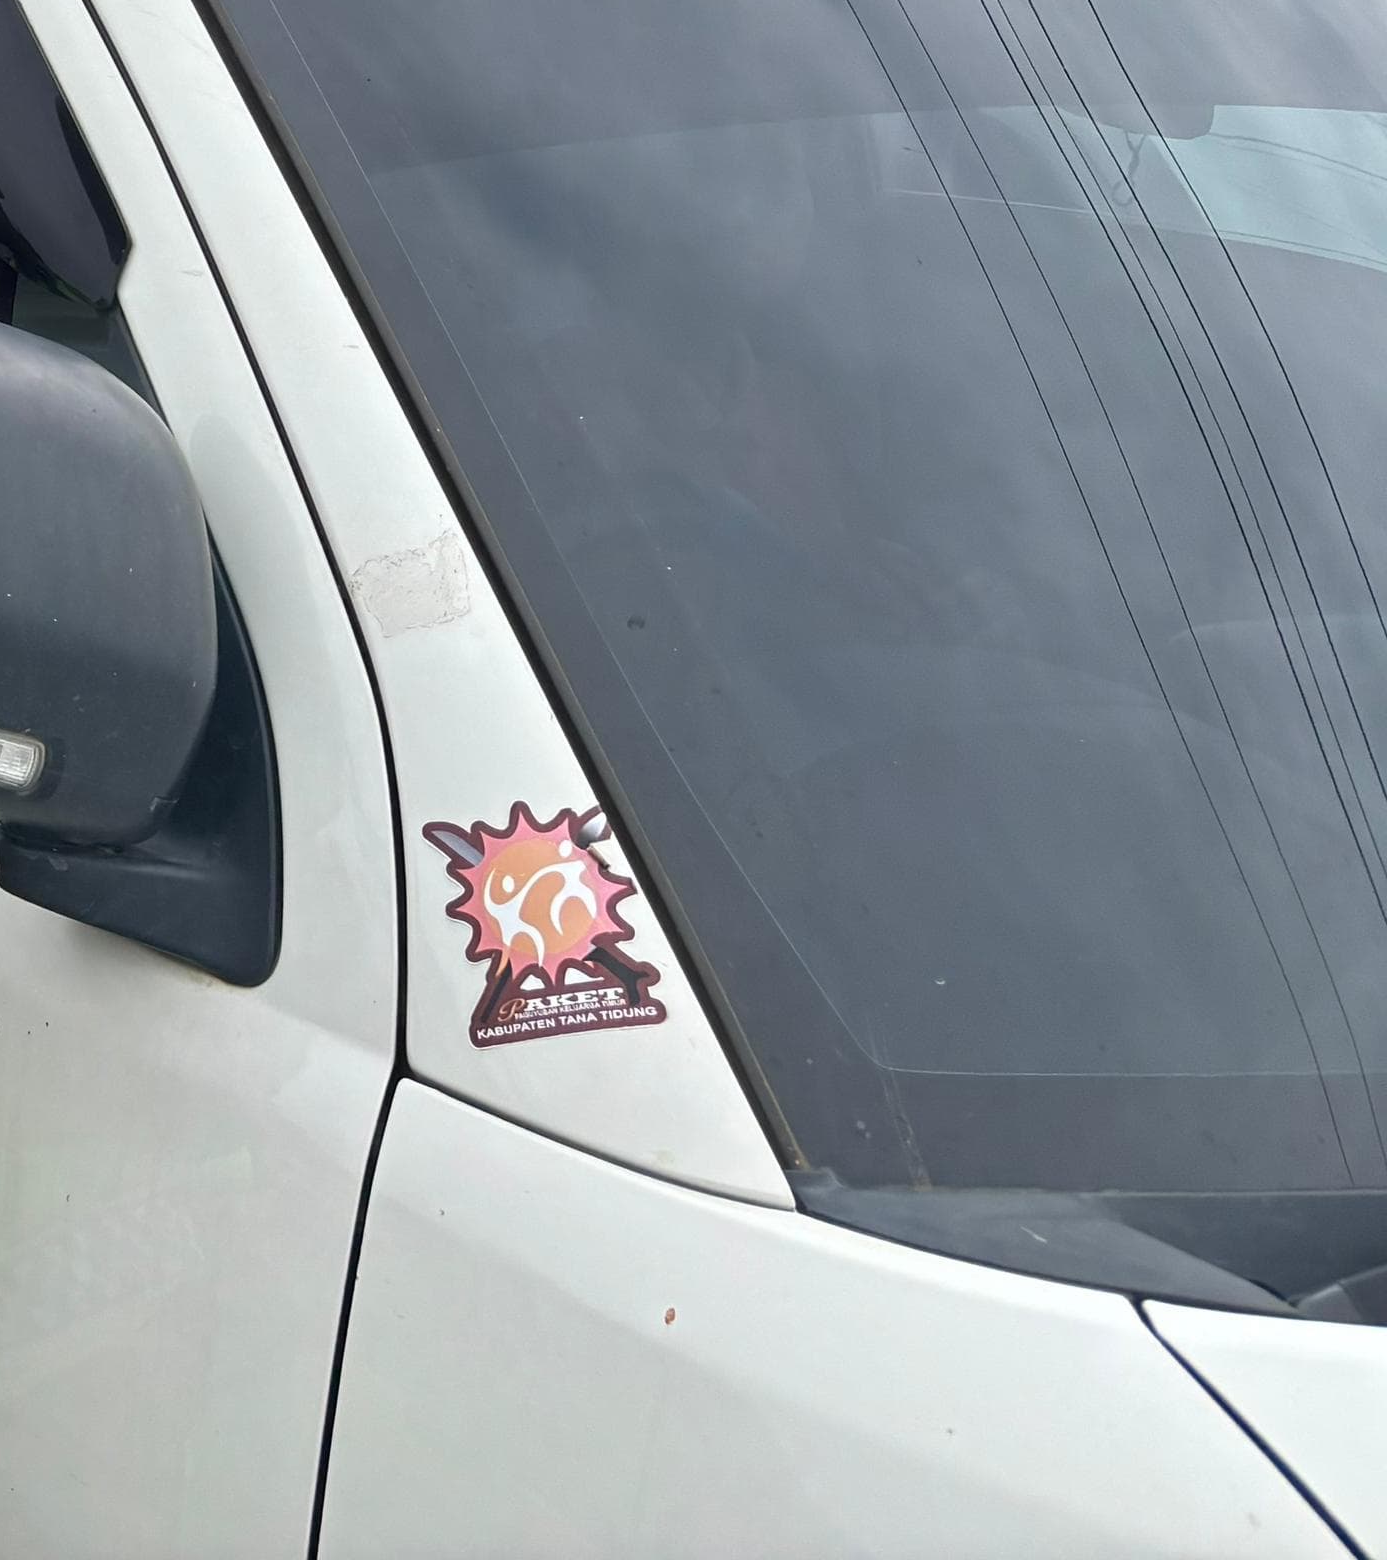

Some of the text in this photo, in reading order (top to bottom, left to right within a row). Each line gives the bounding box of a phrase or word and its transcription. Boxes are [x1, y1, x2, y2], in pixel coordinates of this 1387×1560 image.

[497, 987, 624, 1022] PAKET
[477, 1006, 658, 1040] KABUPATEN TANA TIDUNG
